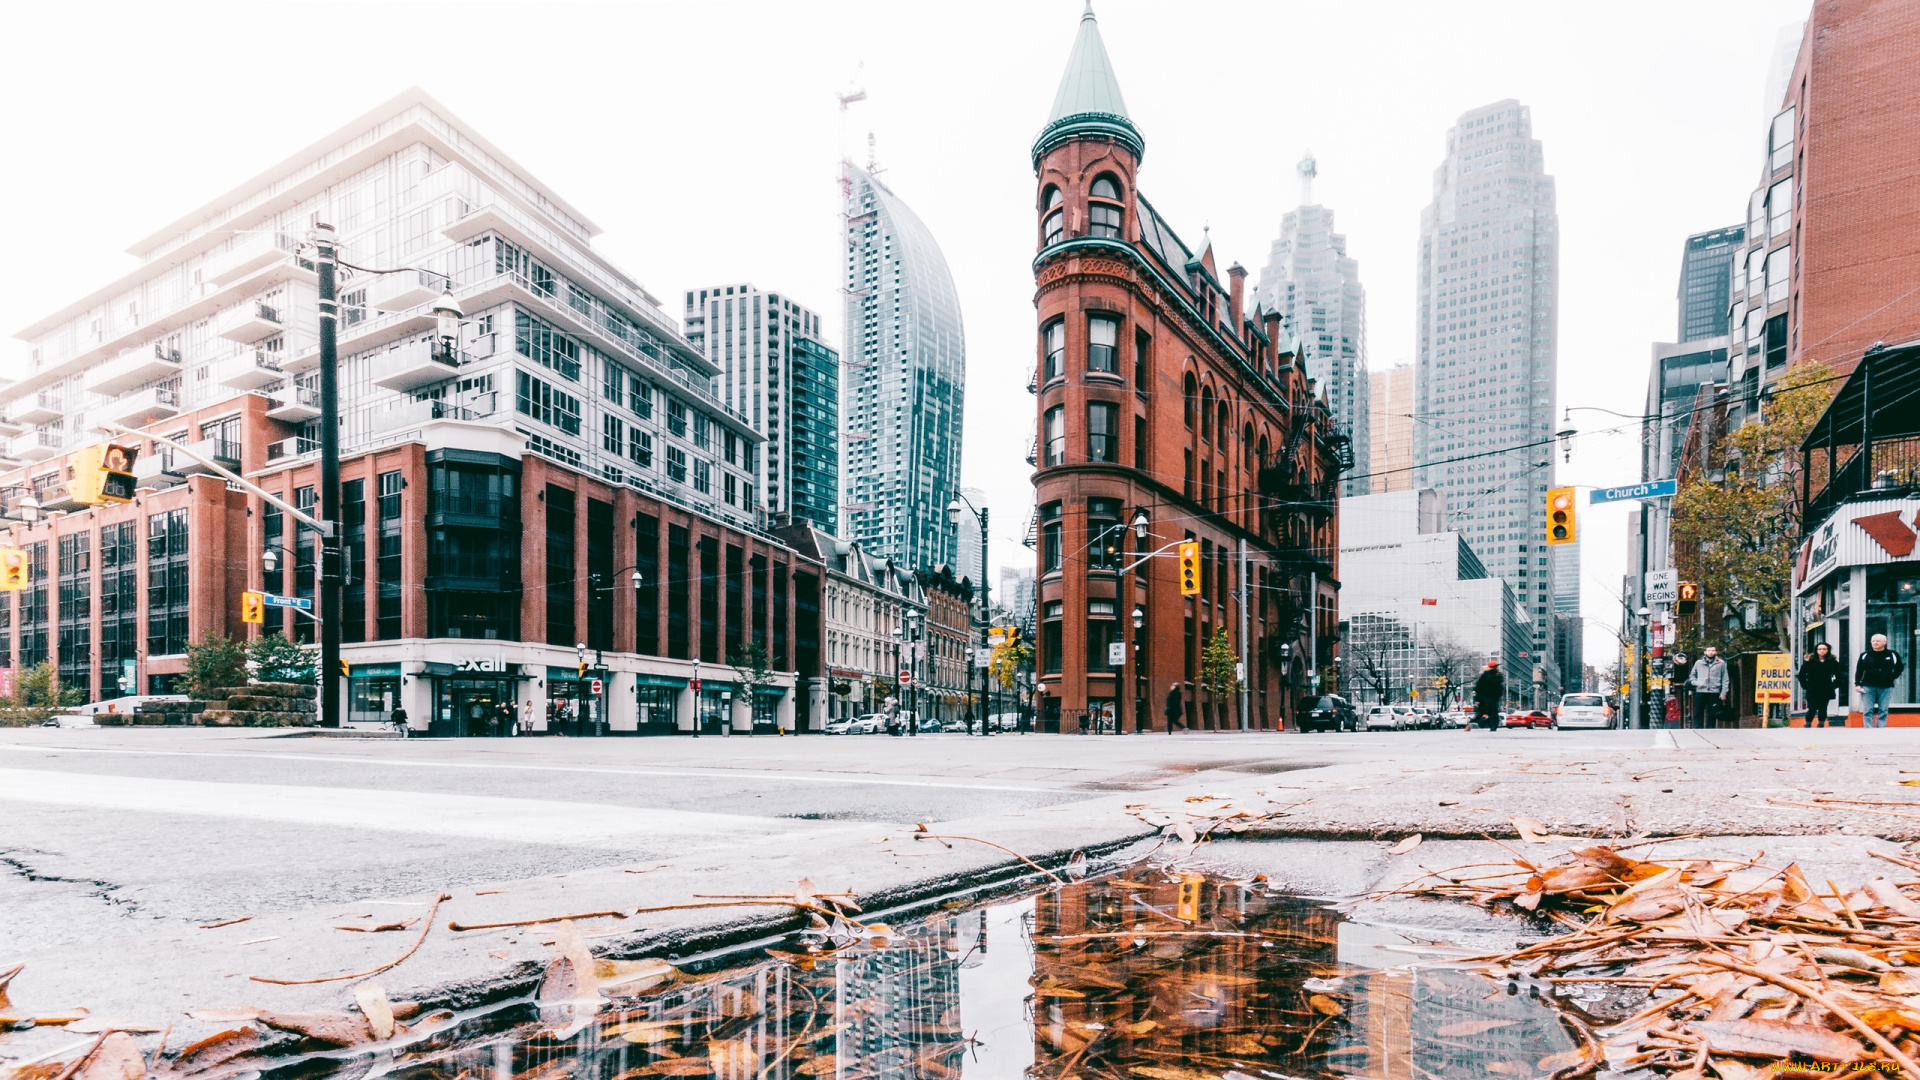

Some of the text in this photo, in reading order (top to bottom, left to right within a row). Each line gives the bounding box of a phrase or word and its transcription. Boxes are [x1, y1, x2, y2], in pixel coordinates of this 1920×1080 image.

[1606, 485, 1649, 499] Church
[1653, 572, 1669, 580] ONE
[1653, 582, 1669, 590] WAY
[1646, 591, 1676, 600] BEGINS
[1760, 668, 1791, 678] PUBLIC
